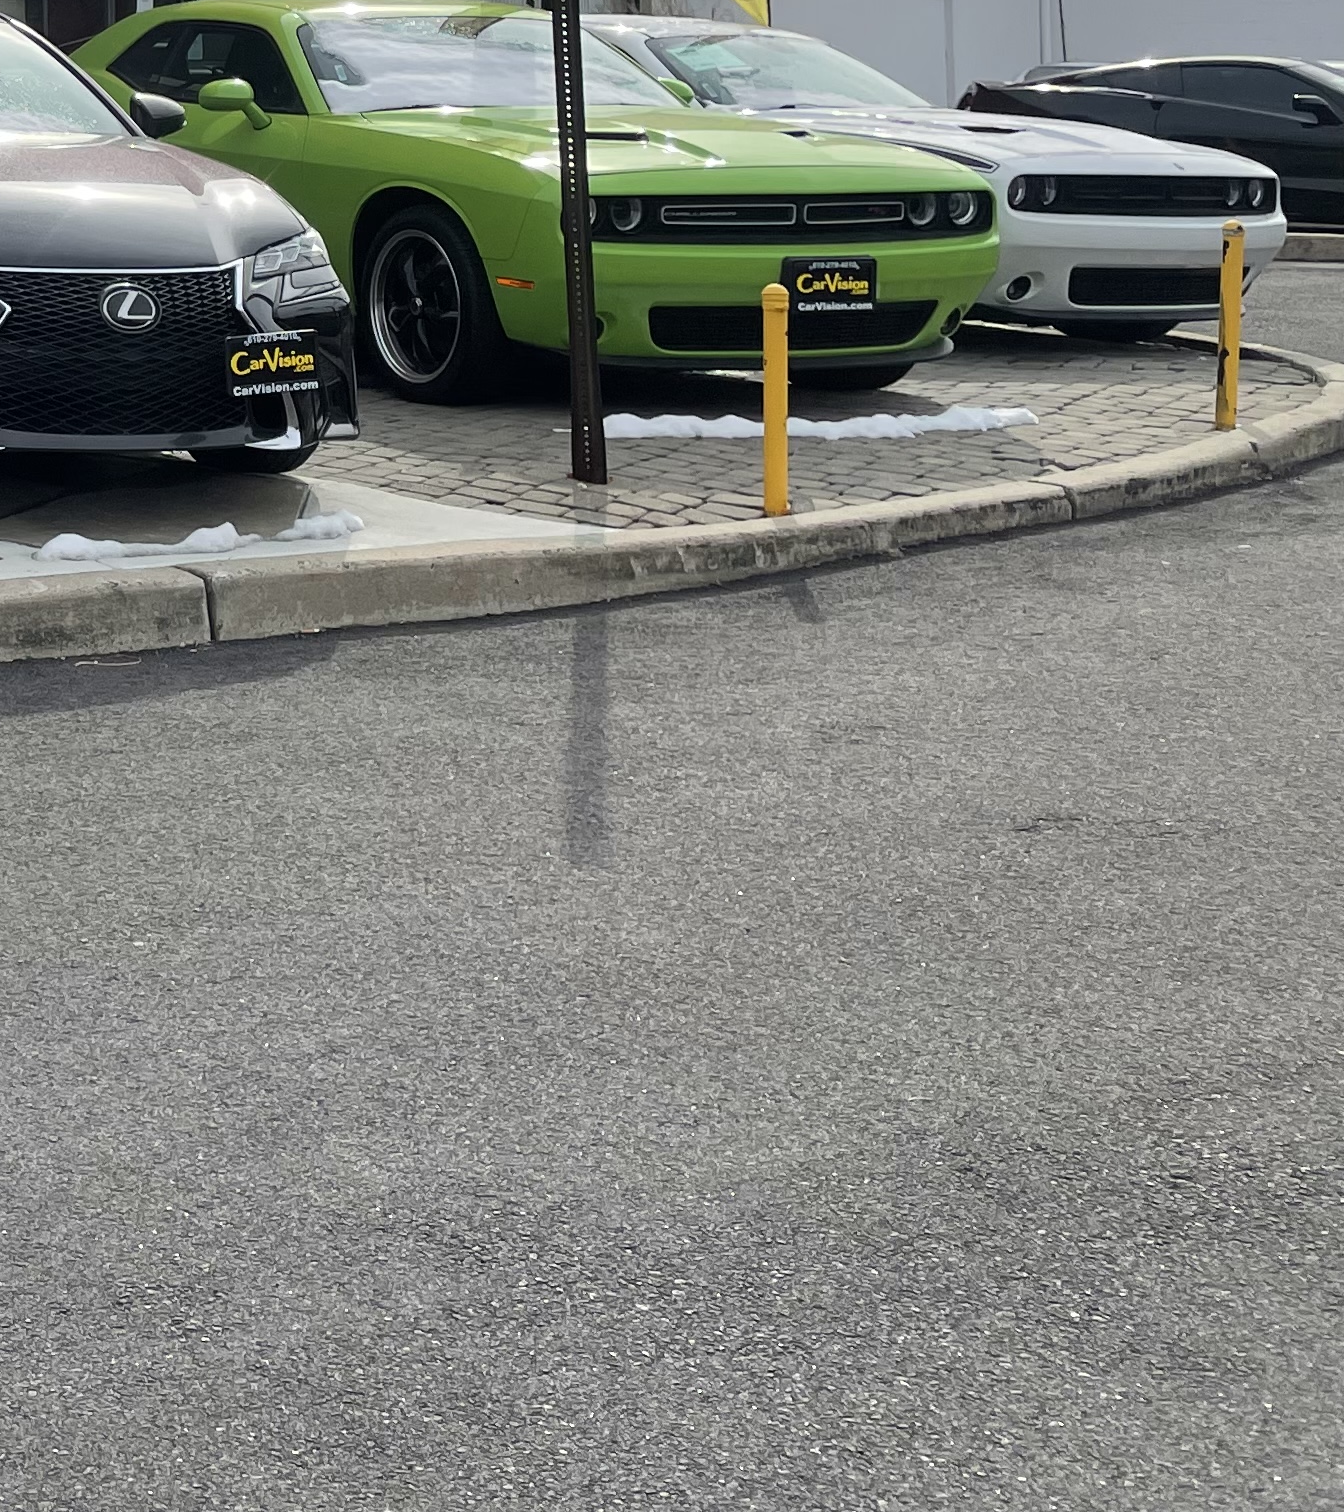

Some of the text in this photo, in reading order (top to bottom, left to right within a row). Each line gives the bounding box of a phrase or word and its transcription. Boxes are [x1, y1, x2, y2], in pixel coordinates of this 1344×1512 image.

[796, 272, 869, 294] CarVision
[797, 302, 873, 311] CarVision.com
[230, 347, 314, 376] CarVision
[233, 381, 319, 397] CarVision.com
